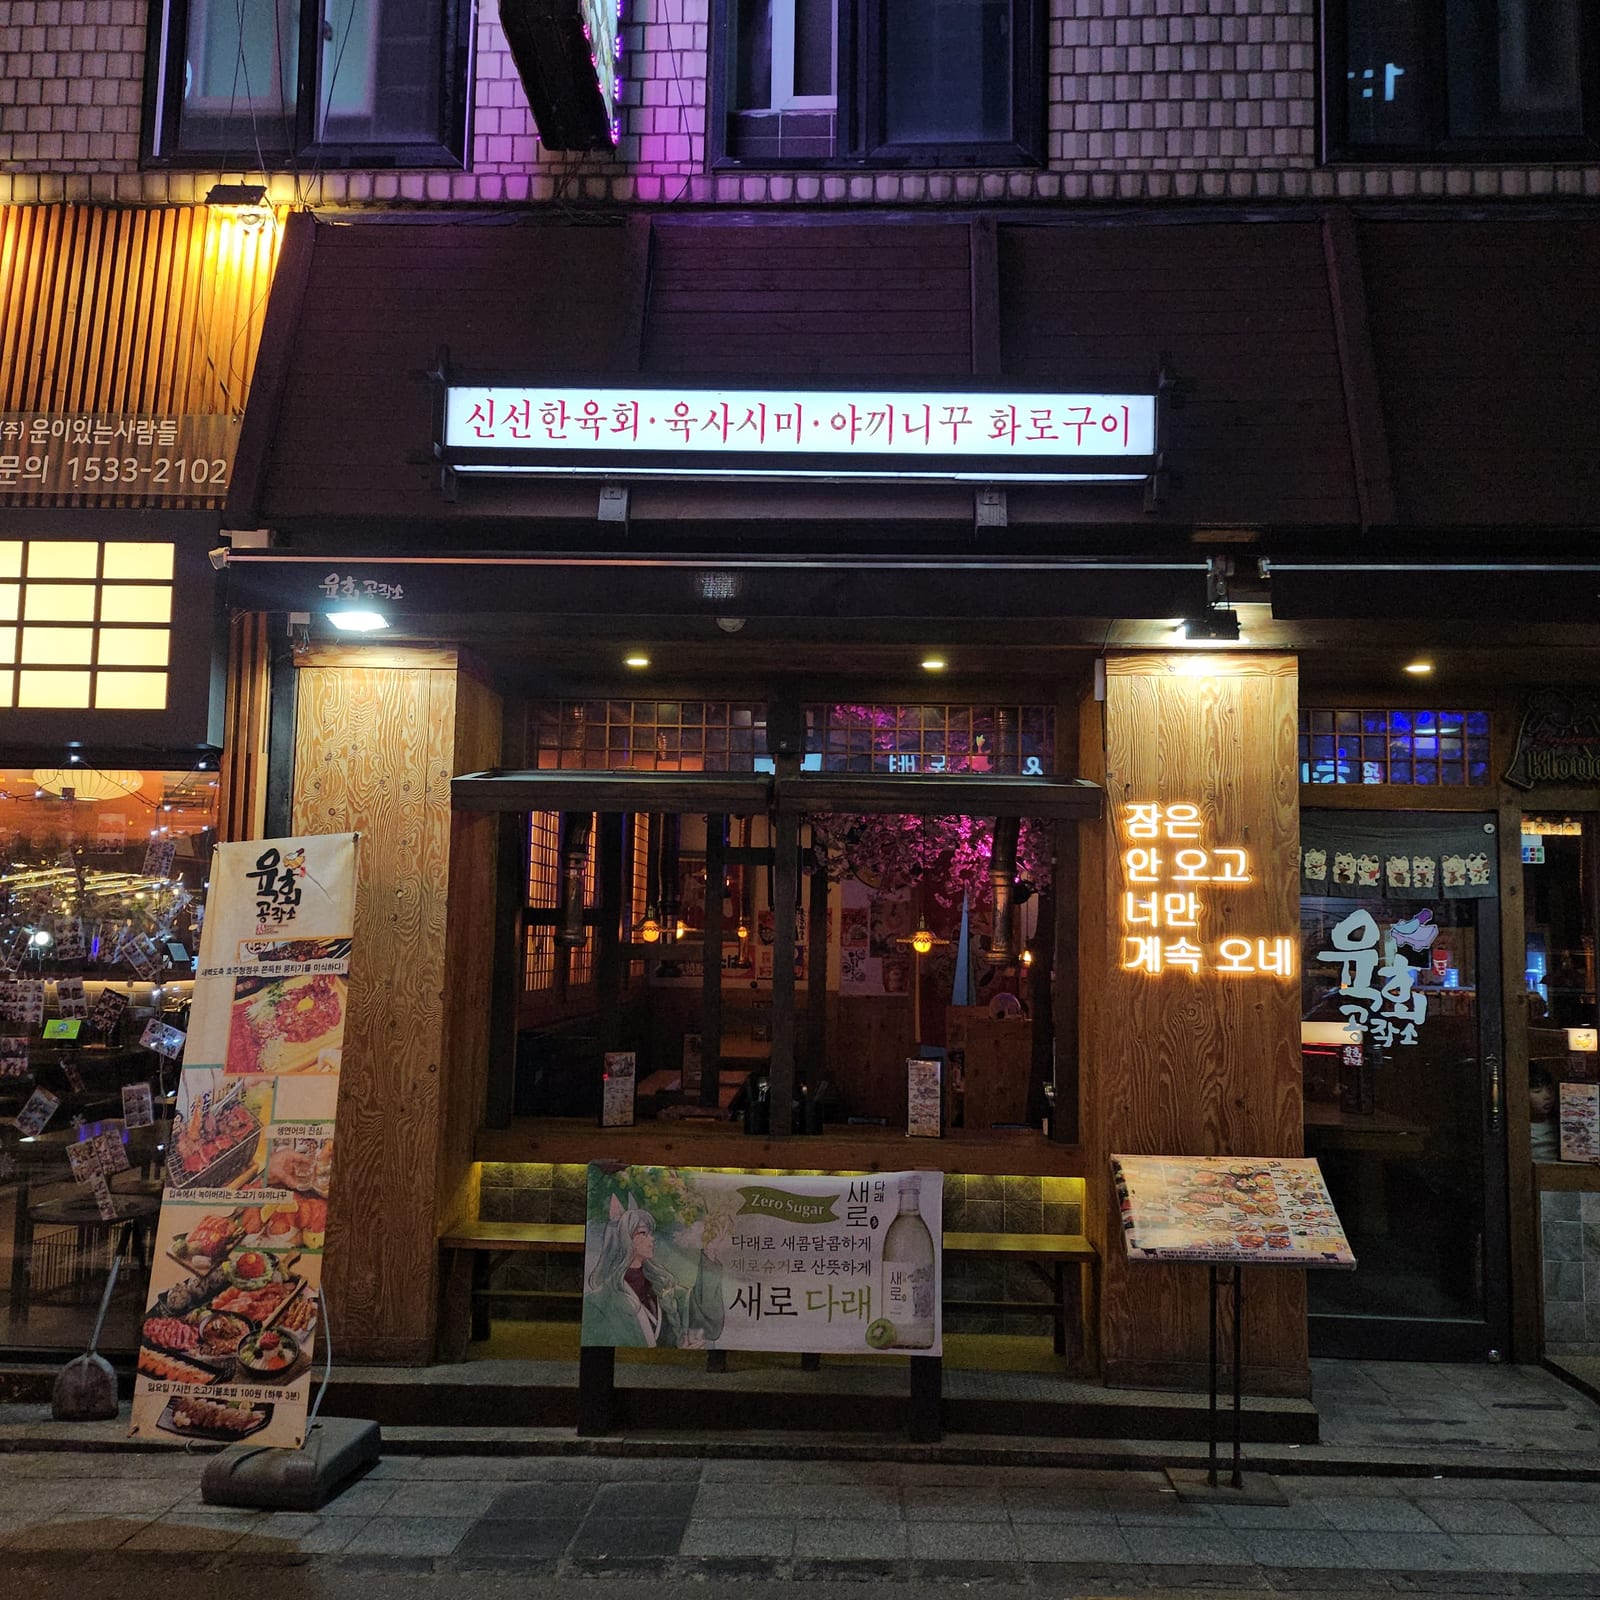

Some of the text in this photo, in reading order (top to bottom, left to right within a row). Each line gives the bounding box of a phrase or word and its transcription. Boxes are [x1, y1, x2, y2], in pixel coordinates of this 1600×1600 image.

[29, 418, 179, 446] 운이있는사람들
[987, 404, 1130, 448] 화로구이
[0, 454, 228, 485] 문의 1533-2102
[318, 572, 404, 602] 육회 공작소
[1125, 803, 1202, 839] 잠은
[246, 848, 302, 907] 육회
[1125, 847, 1251, 883] 안 오고
[256, 901, 297, 924] 공작소
[1126, 891, 1201, 928] 너만
[1125, 936, 1292, 977] 계속 오네
[1316, 908, 1429, 1026] 육회
[1339, 1004, 1419, 1048] 공작소
[234, 1190, 256, 1200] 소고기
[751, 1193, 825, 1219] Zero Sugar
[846, 1180, 869, 1228] 새로
[731, 1235, 872, 1253] 다래로 새콤달콤하게
[810, 1258, 872, 1277] 산뜻하게
[729, 1282, 872, 1324] 새로 다래
[240, 1388, 263, 1400] 100원
